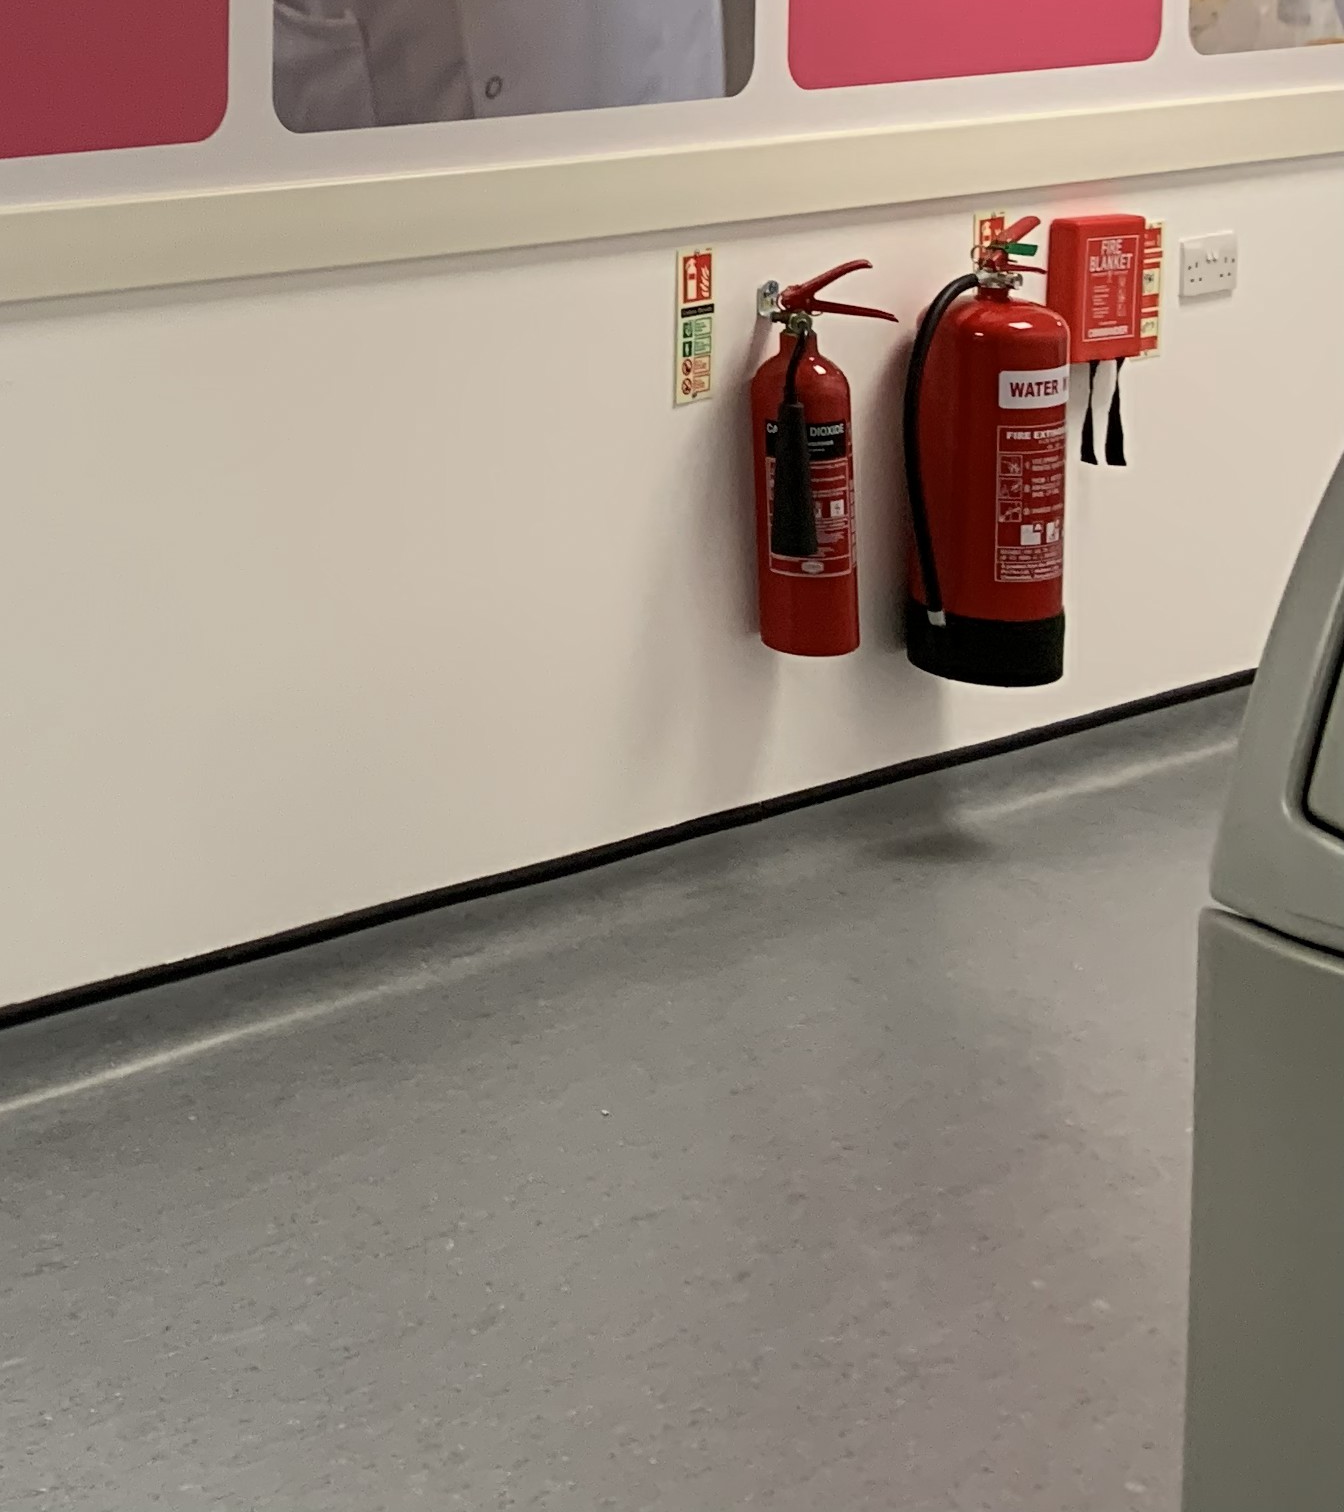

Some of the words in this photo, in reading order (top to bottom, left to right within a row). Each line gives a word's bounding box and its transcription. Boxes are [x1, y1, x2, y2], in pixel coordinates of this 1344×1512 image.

[1100, 239, 1123, 255] FIRE
[1089, 253, 1133, 272] BLANKET
[1009, 380, 1059, 398] WATER
[810, 423, 845, 436] DIOXIDE
[1006, 431, 1031, 440] FIRE
